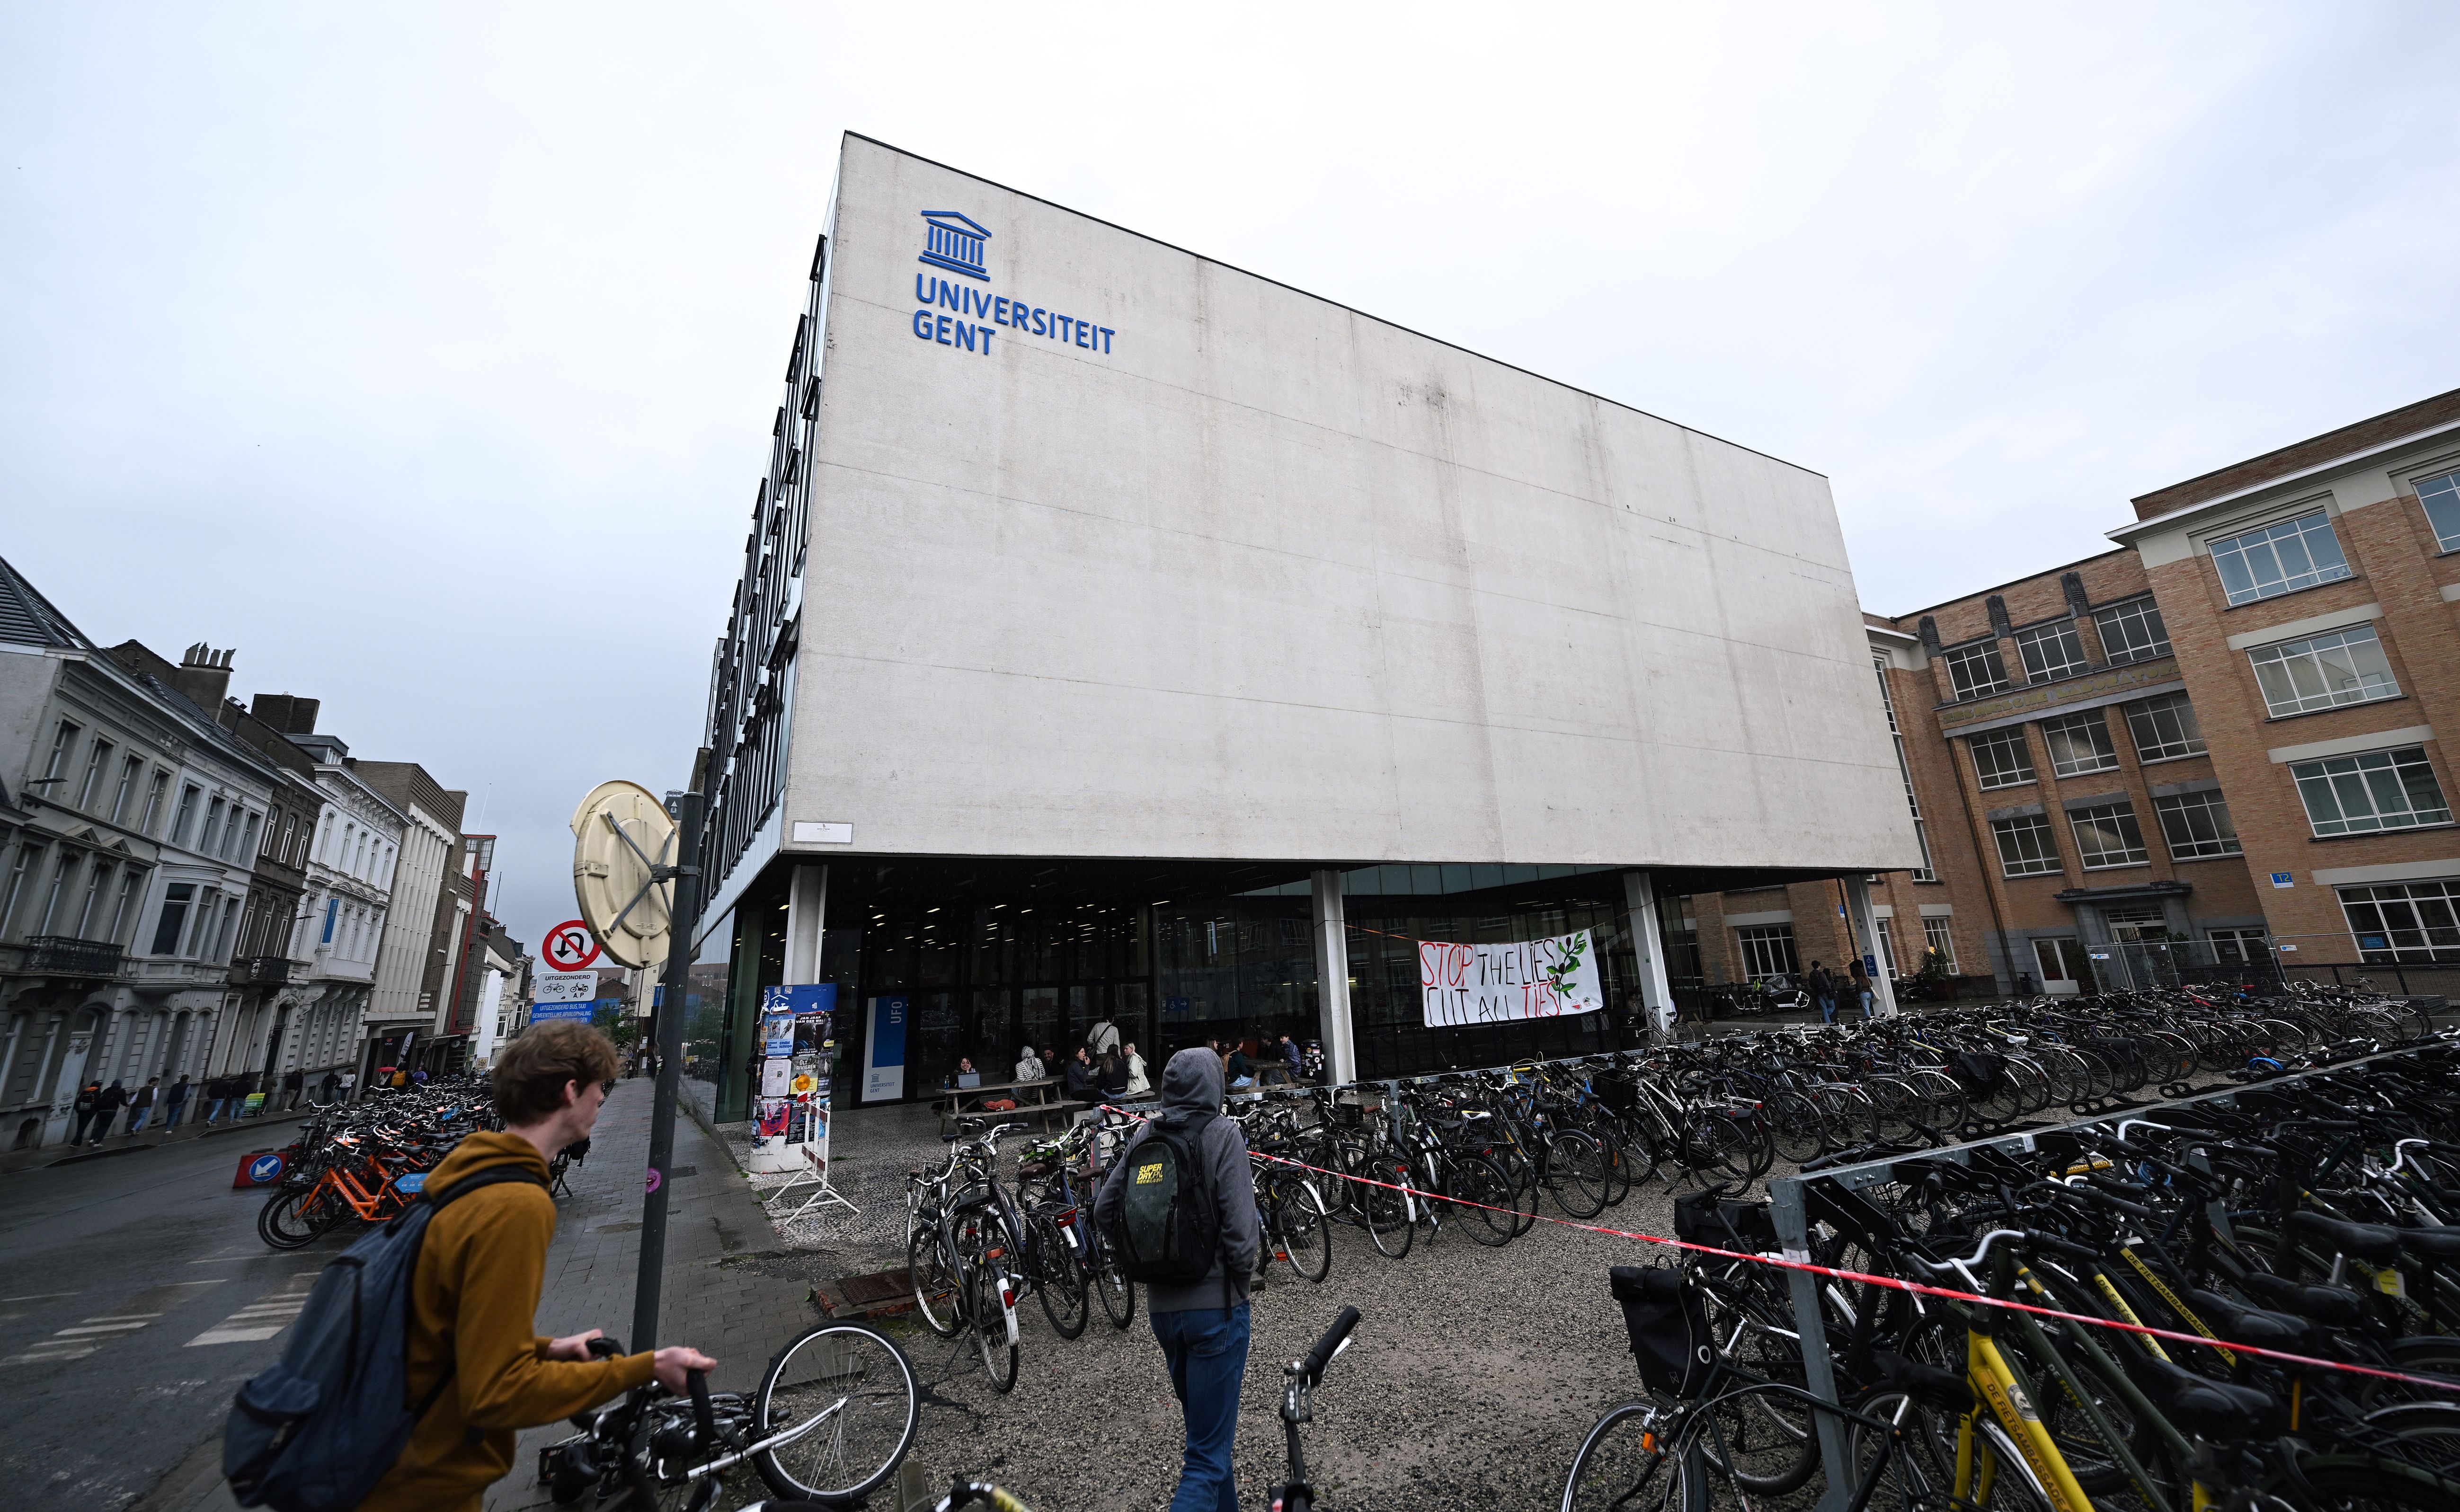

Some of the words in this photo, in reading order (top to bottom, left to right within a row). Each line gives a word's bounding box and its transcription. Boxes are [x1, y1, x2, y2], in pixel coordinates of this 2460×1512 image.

[916, 273, 1115, 354] UNIVERSITEIT
[913, 309, 996, 355] GENT
[1943, 691, 2049, 724] TECHNISCHE
[2276, 874, 2291, 882] T2
[1420, 941, 1474, 987] STOP
[1477, 951, 1515, 986] THE
[890, 1001, 903, 1024] UFO
[1427, 987, 1469, 1027] CUT
[1139, 1163, 1163, 1174] SUPER
[2127, 1254, 2139, 1266] DE
[2097, 1279, 2111, 1292] DE
[2047, 1363, 2061, 1379] DE
[1987, 1383, 2000, 1399] DE
[1728, 1473, 1745, 1507] RALEIGH
